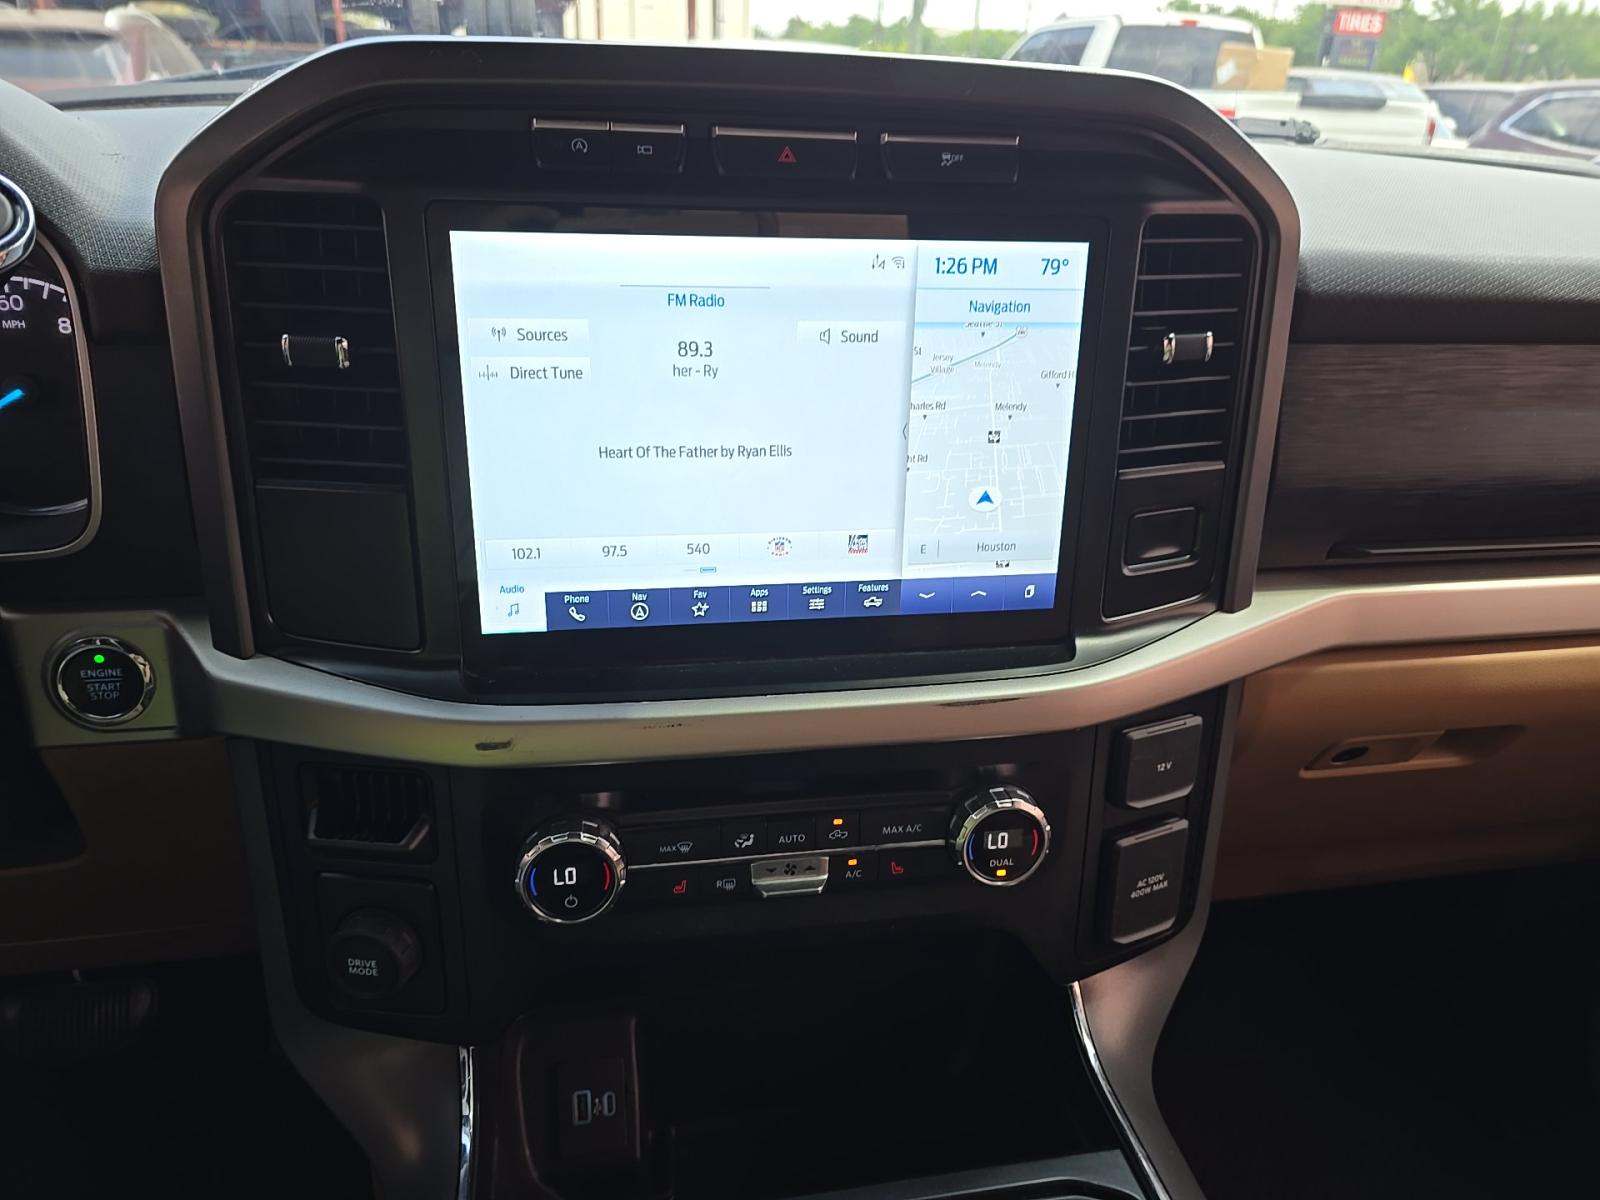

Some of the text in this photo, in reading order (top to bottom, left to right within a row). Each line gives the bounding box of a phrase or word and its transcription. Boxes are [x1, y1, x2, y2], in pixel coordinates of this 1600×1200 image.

[1340, 12, 1382, 33] TIRES
[935, 257, 998, 275] 1:26 PM
[667, 293, 725, 308] FM Radio
[969, 300, 1031, 315] Navigation
[2, 320, 26, 329] MPH
[517, 328, 568, 342] Sources
[841, 329, 879, 343] Sound
[677, 341, 713, 357] 89.3
[510, 366, 583, 380] Direct Tune
[673, 364, 693, 377] her
[703, 364, 719, 379] Ry
[935, 401, 947, 411] Rd
[599, 444, 793, 460] Heart Of The Father by Ryan Ellis
[602, 544, 628, 558] 97.5
[686, 542, 711, 555] 540
[920, 544, 927, 554] E
[976, 542, 1017, 553] Houston
[512, 547, 541, 560] 102.1
[499, 585, 525, 594] Audio
[750, 587, 769, 598] Apps
[802, 585, 833, 596] Settings
[858, 583, 889, 593] Features
[564, 594, 590, 604] Phone
[632, 592, 648, 601] Nav
[693, 590, 708, 599] Fav
[80, 669, 123, 678] ENGINE
[87, 682, 121, 692] START
[89, 691, 120, 701] STOP
[882, 823, 923, 836] MAX A/C
[778, 833, 806, 845] AUTO
[987, 832, 1009, 850] LO
[659, 845, 677, 854] MAX
[989, 858, 1015, 868] DUAL
[553, 866, 577, 886] LO
[845, 869, 862, 879] A/C
[1136, 873, 1165, 889] AC 120V
[1152, 880, 1168, 892] MAX
[347, 958, 377, 968] DRIVE
[348, 967, 379, 977] MODE
